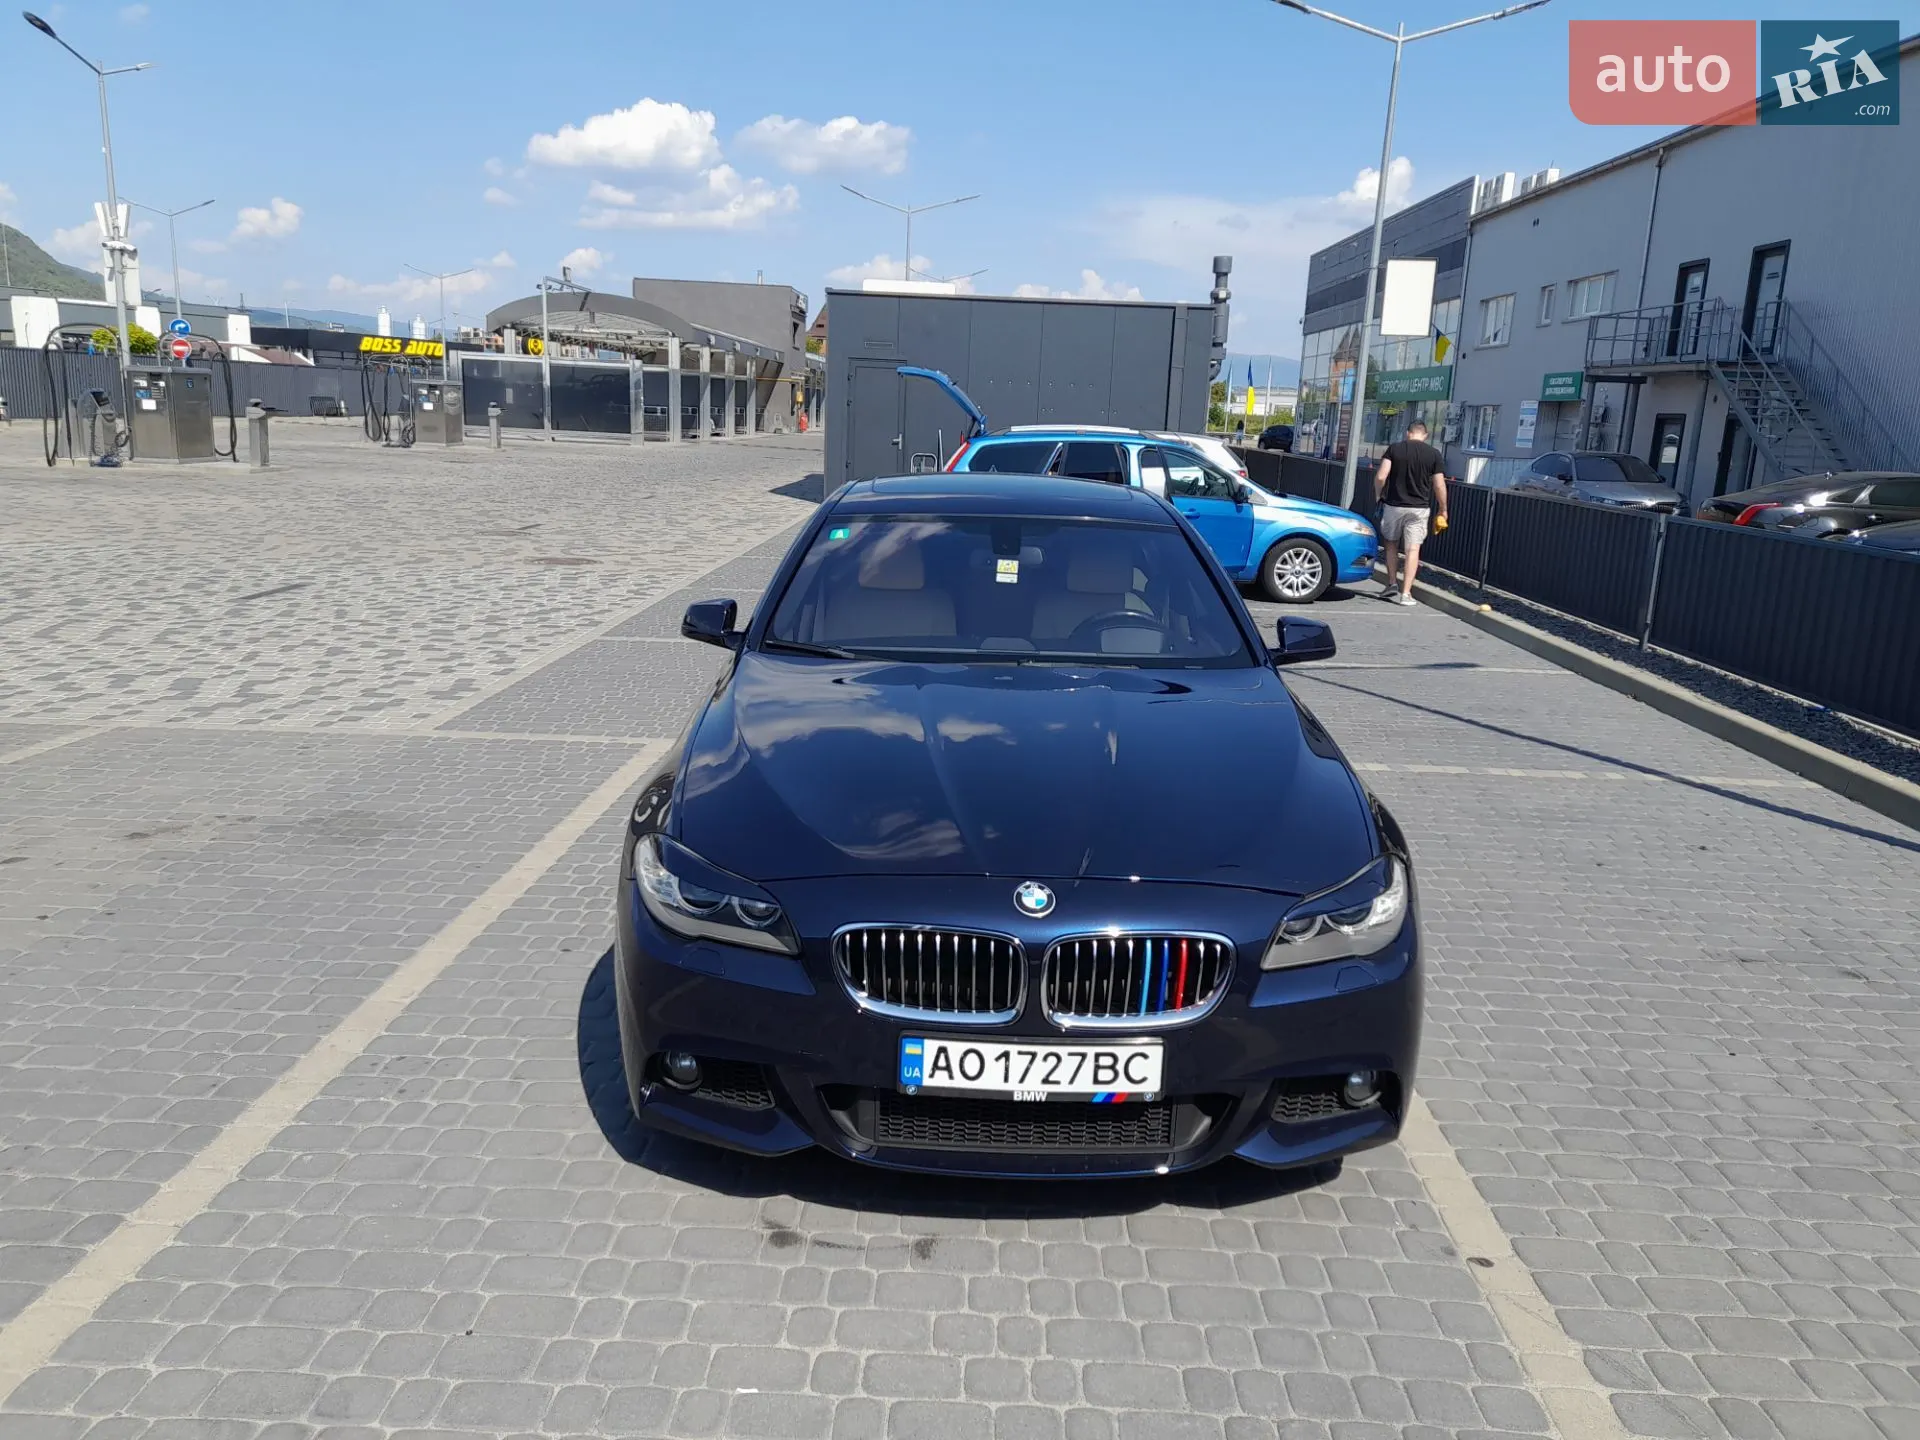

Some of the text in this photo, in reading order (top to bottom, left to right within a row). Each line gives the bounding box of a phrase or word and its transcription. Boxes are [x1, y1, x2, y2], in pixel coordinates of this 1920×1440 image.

[360, 336, 402, 353] BOSS
[904, 1066, 921, 1078] UA
[1013, 1090, 1047, 1102] BMW
